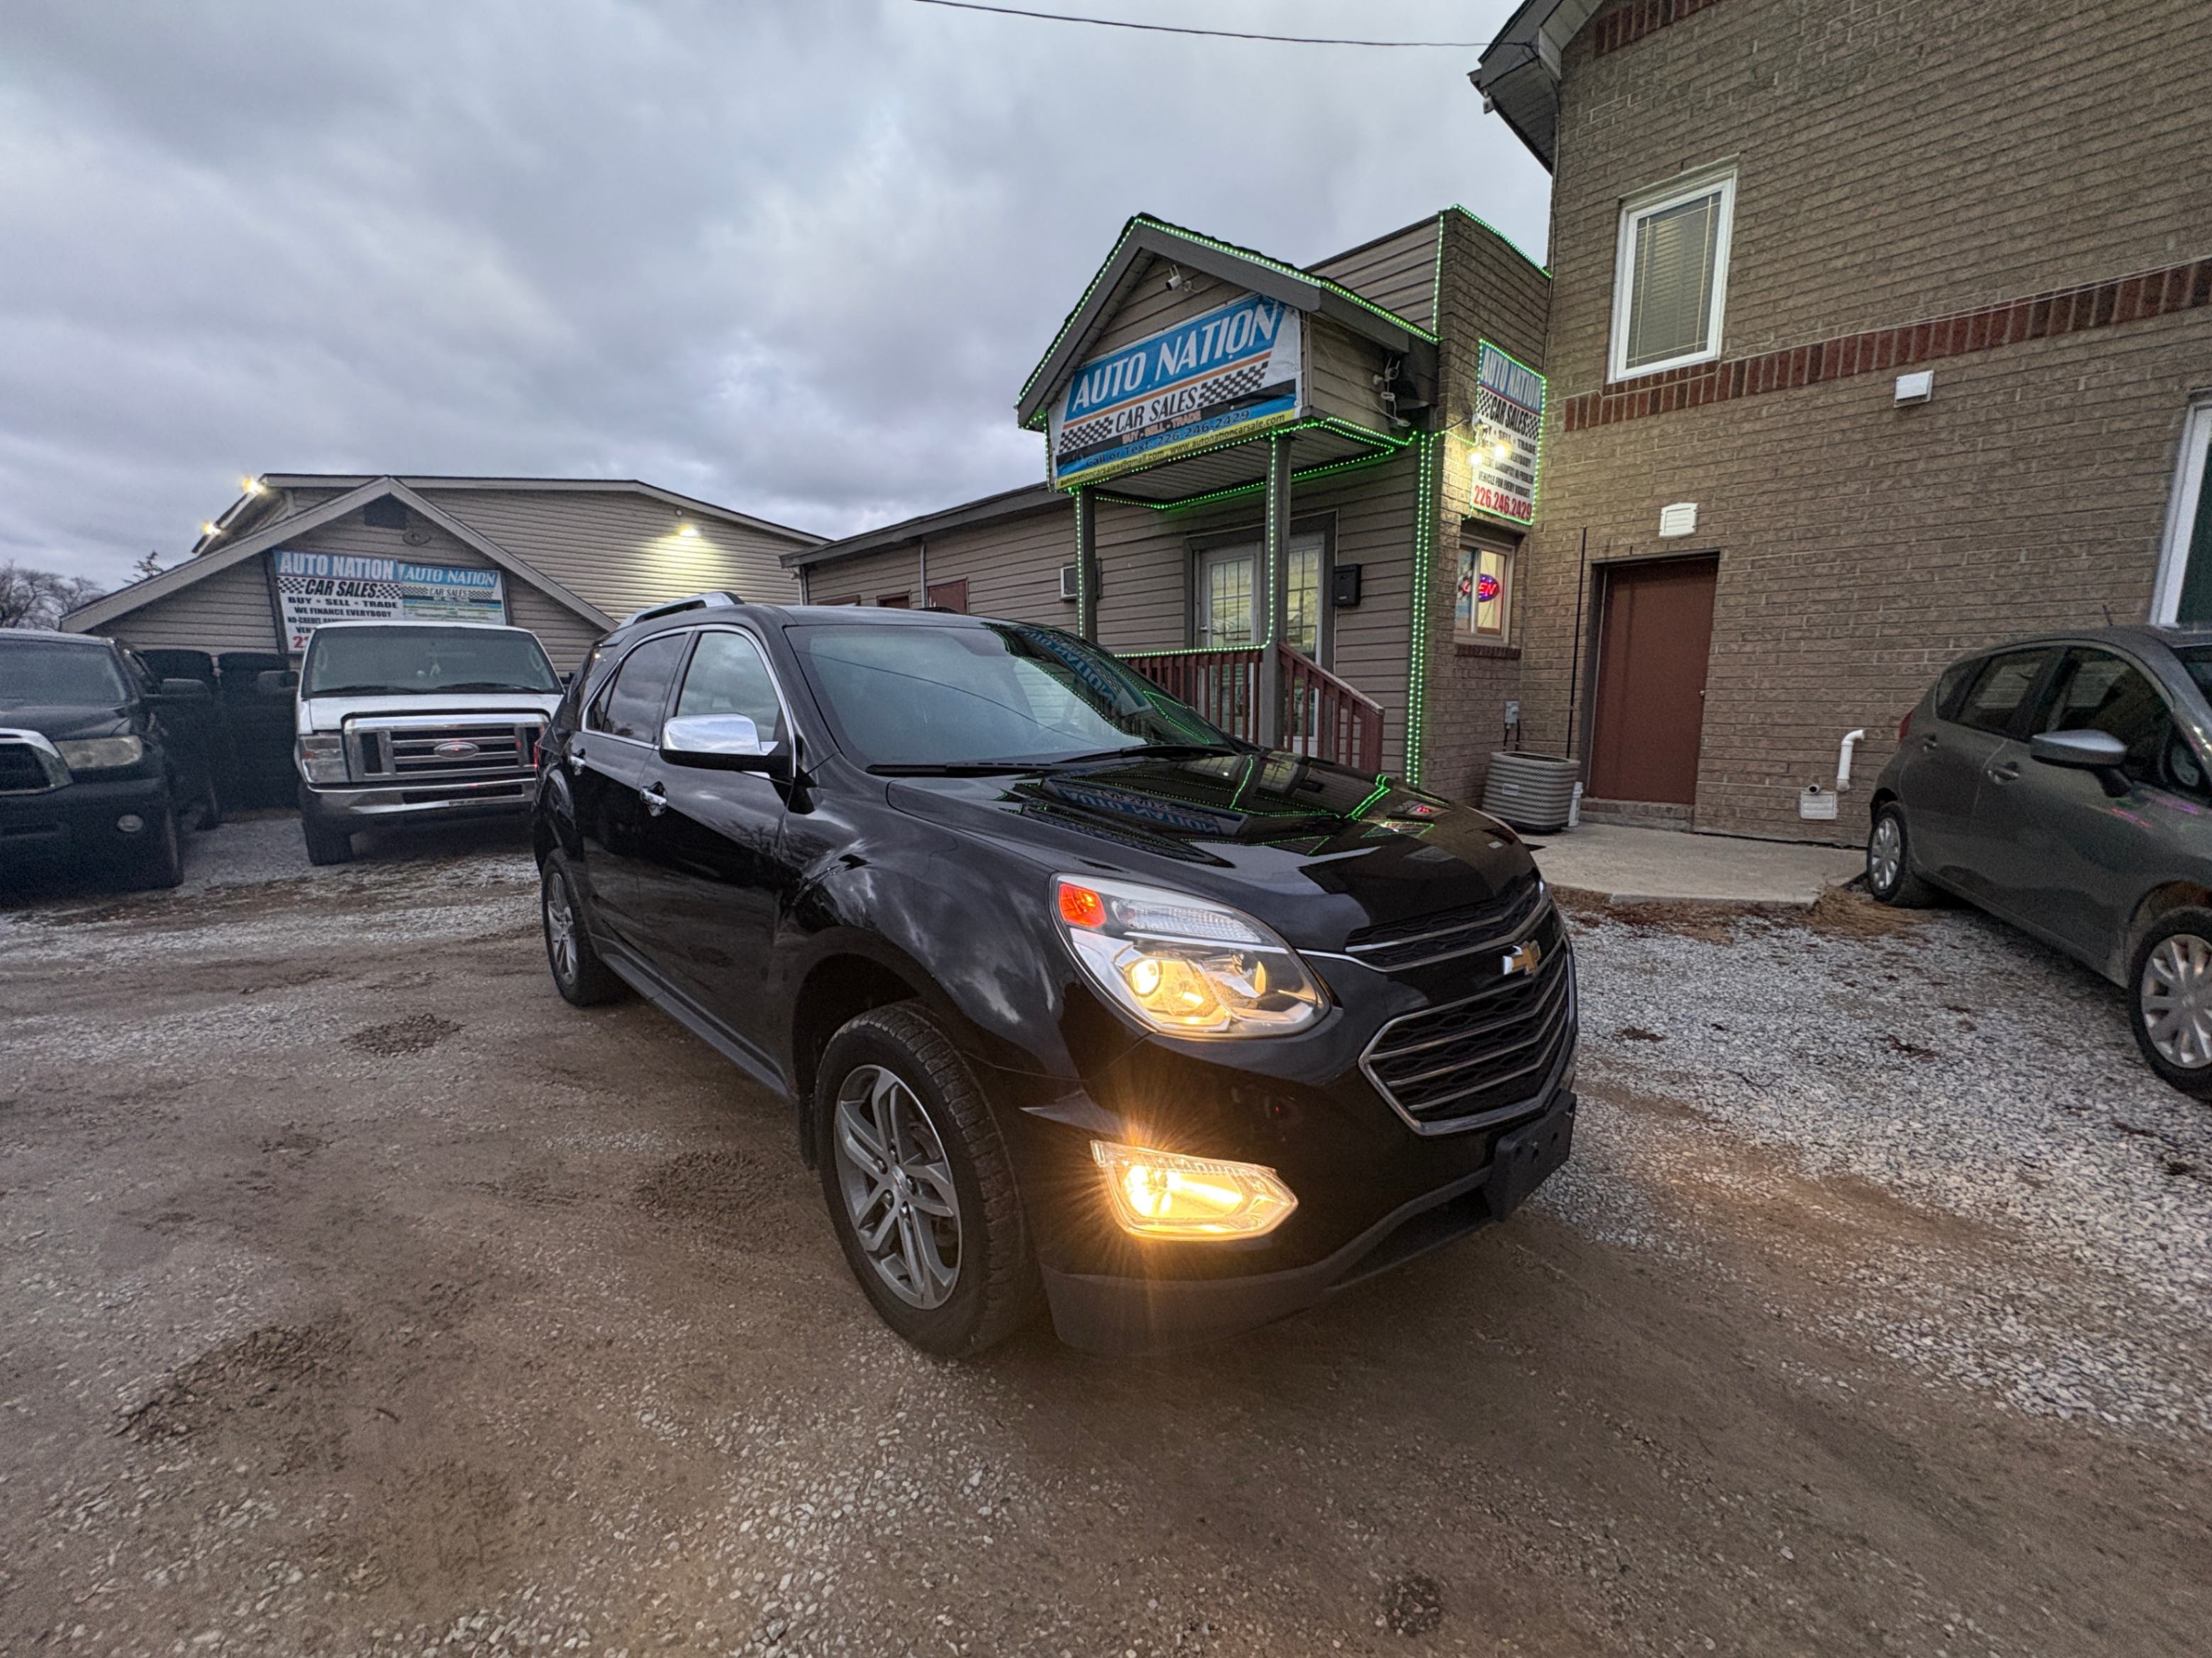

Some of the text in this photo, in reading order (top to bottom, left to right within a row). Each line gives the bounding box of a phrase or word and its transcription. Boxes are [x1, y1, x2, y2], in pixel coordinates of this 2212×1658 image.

[1072, 301, 1281, 413] AUTO NATION
[1481, 348, 1542, 411] AUTO NATION
[1115, 386, 1200, 433] CAR SALES
[1490, 396, 1529, 436] CAR SALES
[1086, 453, 1105, 468] Call
[1110, 450, 1121, 459] or
[1158, 409, 1250, 446] 226-246-2429
[1169, 414, 1285, 455] www.autonationcarsale.com
[1498, 430, 1512, 445] SELL
[1517, 438, 1537, 455] TRADE
[1473, 485, 1533, 521] 226.246.2429
[280, 552, 394, 581] AUTO NATION
[405, 567, 496, 586] AUTO NATION
[288, 596, 312, 604] BUY
[326, 598, 351, 607] SELL
[363, 600, 399, 609] TRADE
[305, 579, 379, 599] CAR SALES
[430, 587, 468, 597] CAR SALES
[310, 607, 345, 616] FINANCE
[346, 609, 392, 618] EVERYBODY
